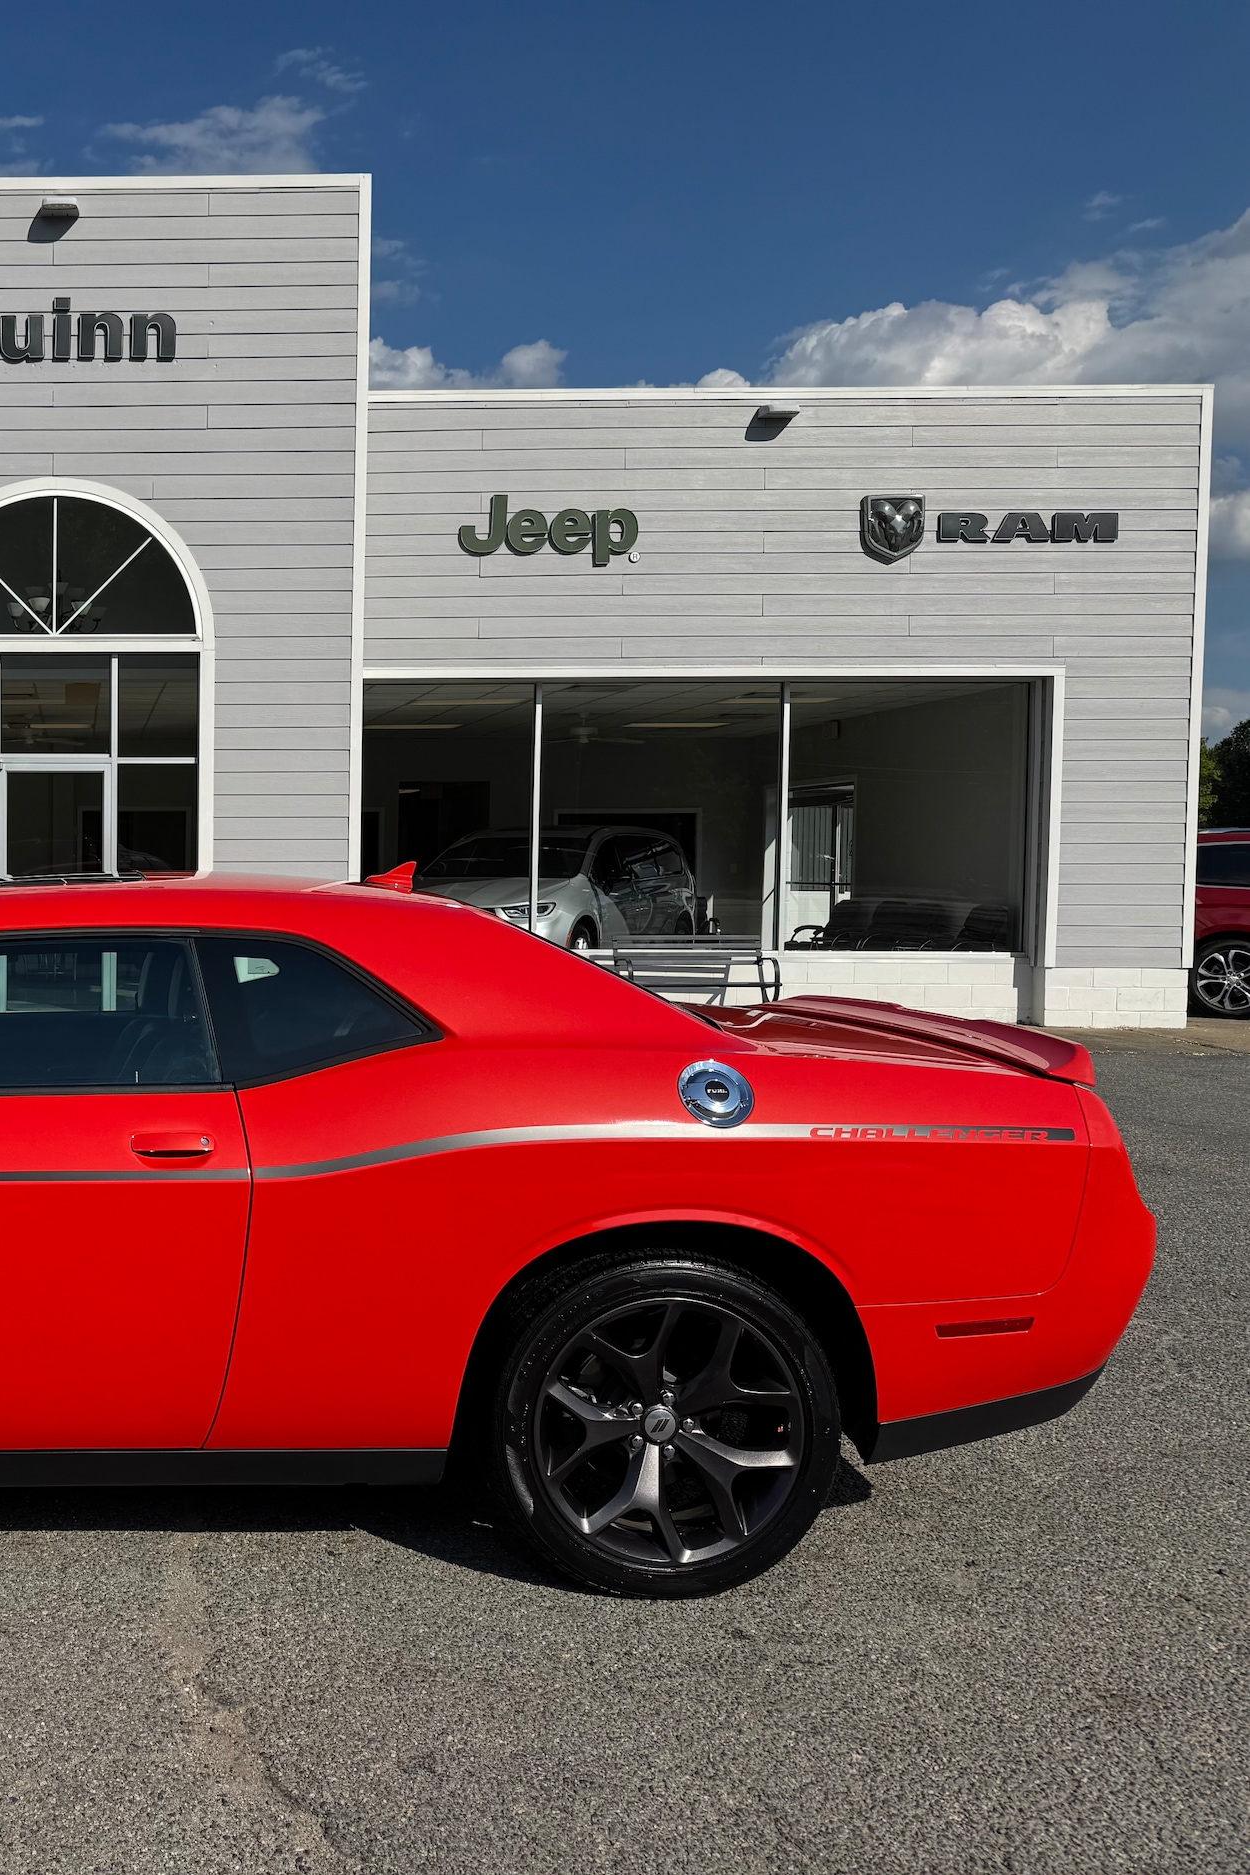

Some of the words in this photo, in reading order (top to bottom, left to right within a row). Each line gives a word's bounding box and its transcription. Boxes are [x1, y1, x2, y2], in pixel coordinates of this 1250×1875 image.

[458, 494, 638, 568] Jeep
[936, 512, 1119, 544] RAM
[809, 1126, 1049, 1142] CHALLENGER
